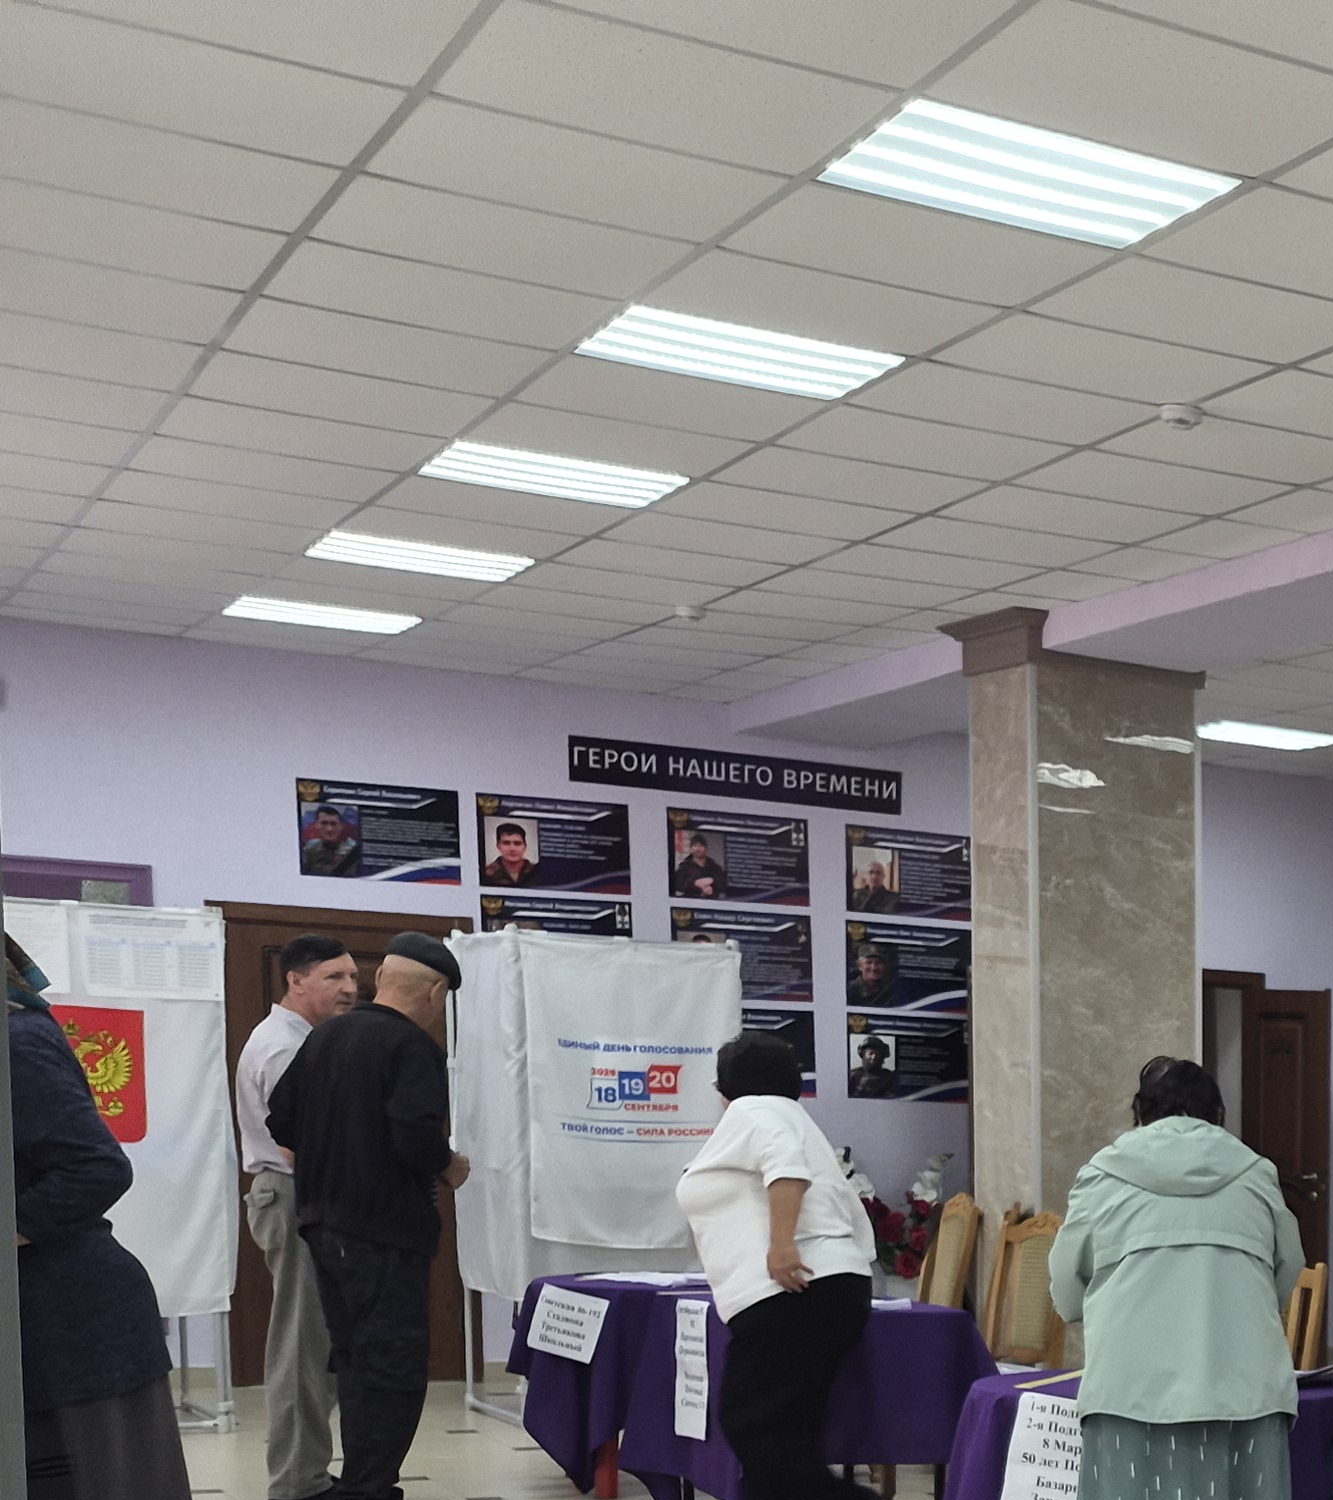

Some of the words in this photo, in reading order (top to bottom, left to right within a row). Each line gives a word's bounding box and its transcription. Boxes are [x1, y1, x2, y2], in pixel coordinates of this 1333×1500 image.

[572, 746, 657, 774] ГЕРОИ
[668, 755, 773, 786] НАШЕГО
[783, 769, 897, 800] ВРЕМЕНИ
[603, 1043, 631, 1053] ДЕНЬ
[634, 1044, 713, 1055] ГОЛОСОВАНИЯ
[595, 1086, 617, 1103] 18
[621, 1078, 644, 1095] 19
[649, 1071, 675, 1088] 20
[624, 1103, 679, 1112] СЕНТЯБРЯ
[561, 1122, 588, 1132] ТВОЙ
[590, 1123, 624, 1135] ГОЛОС
[636, 1127, 665, 1136] СИЛА
[1026, 1417, 1044, 1431] 2-я
[1042, 1438, 1050, 1450] 8
[1021, 1452, 1036, 1465] 50
[1039, 1458, 1061, 1468] лет
